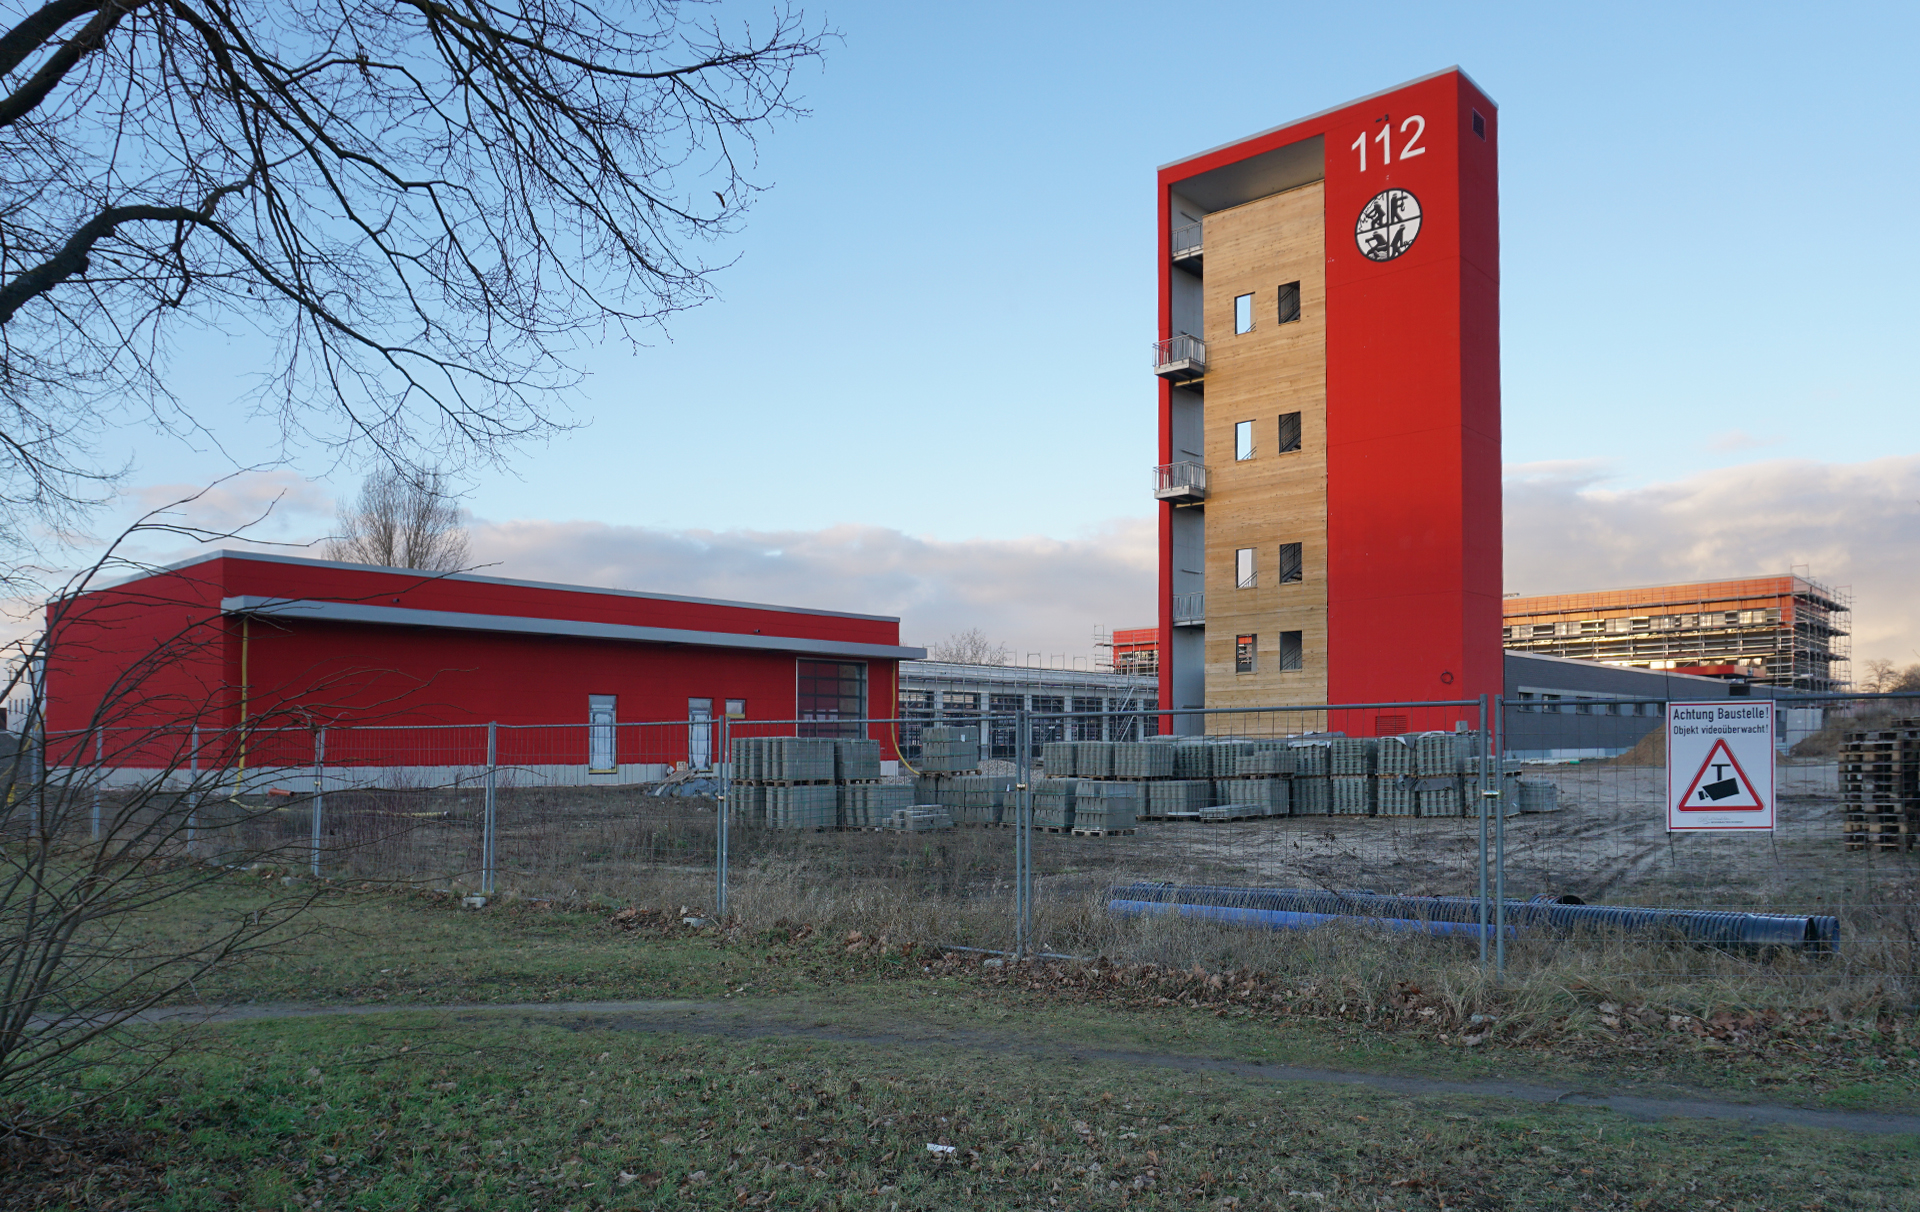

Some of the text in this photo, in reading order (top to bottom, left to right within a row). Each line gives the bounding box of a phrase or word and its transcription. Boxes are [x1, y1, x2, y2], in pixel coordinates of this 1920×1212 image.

[1351, 114, 1426, 172] 112
[1673, 707, 1769, 722] Achtung Baustelle!
[1673, 724, 1769, 737] Objekt videoüberwacht!
